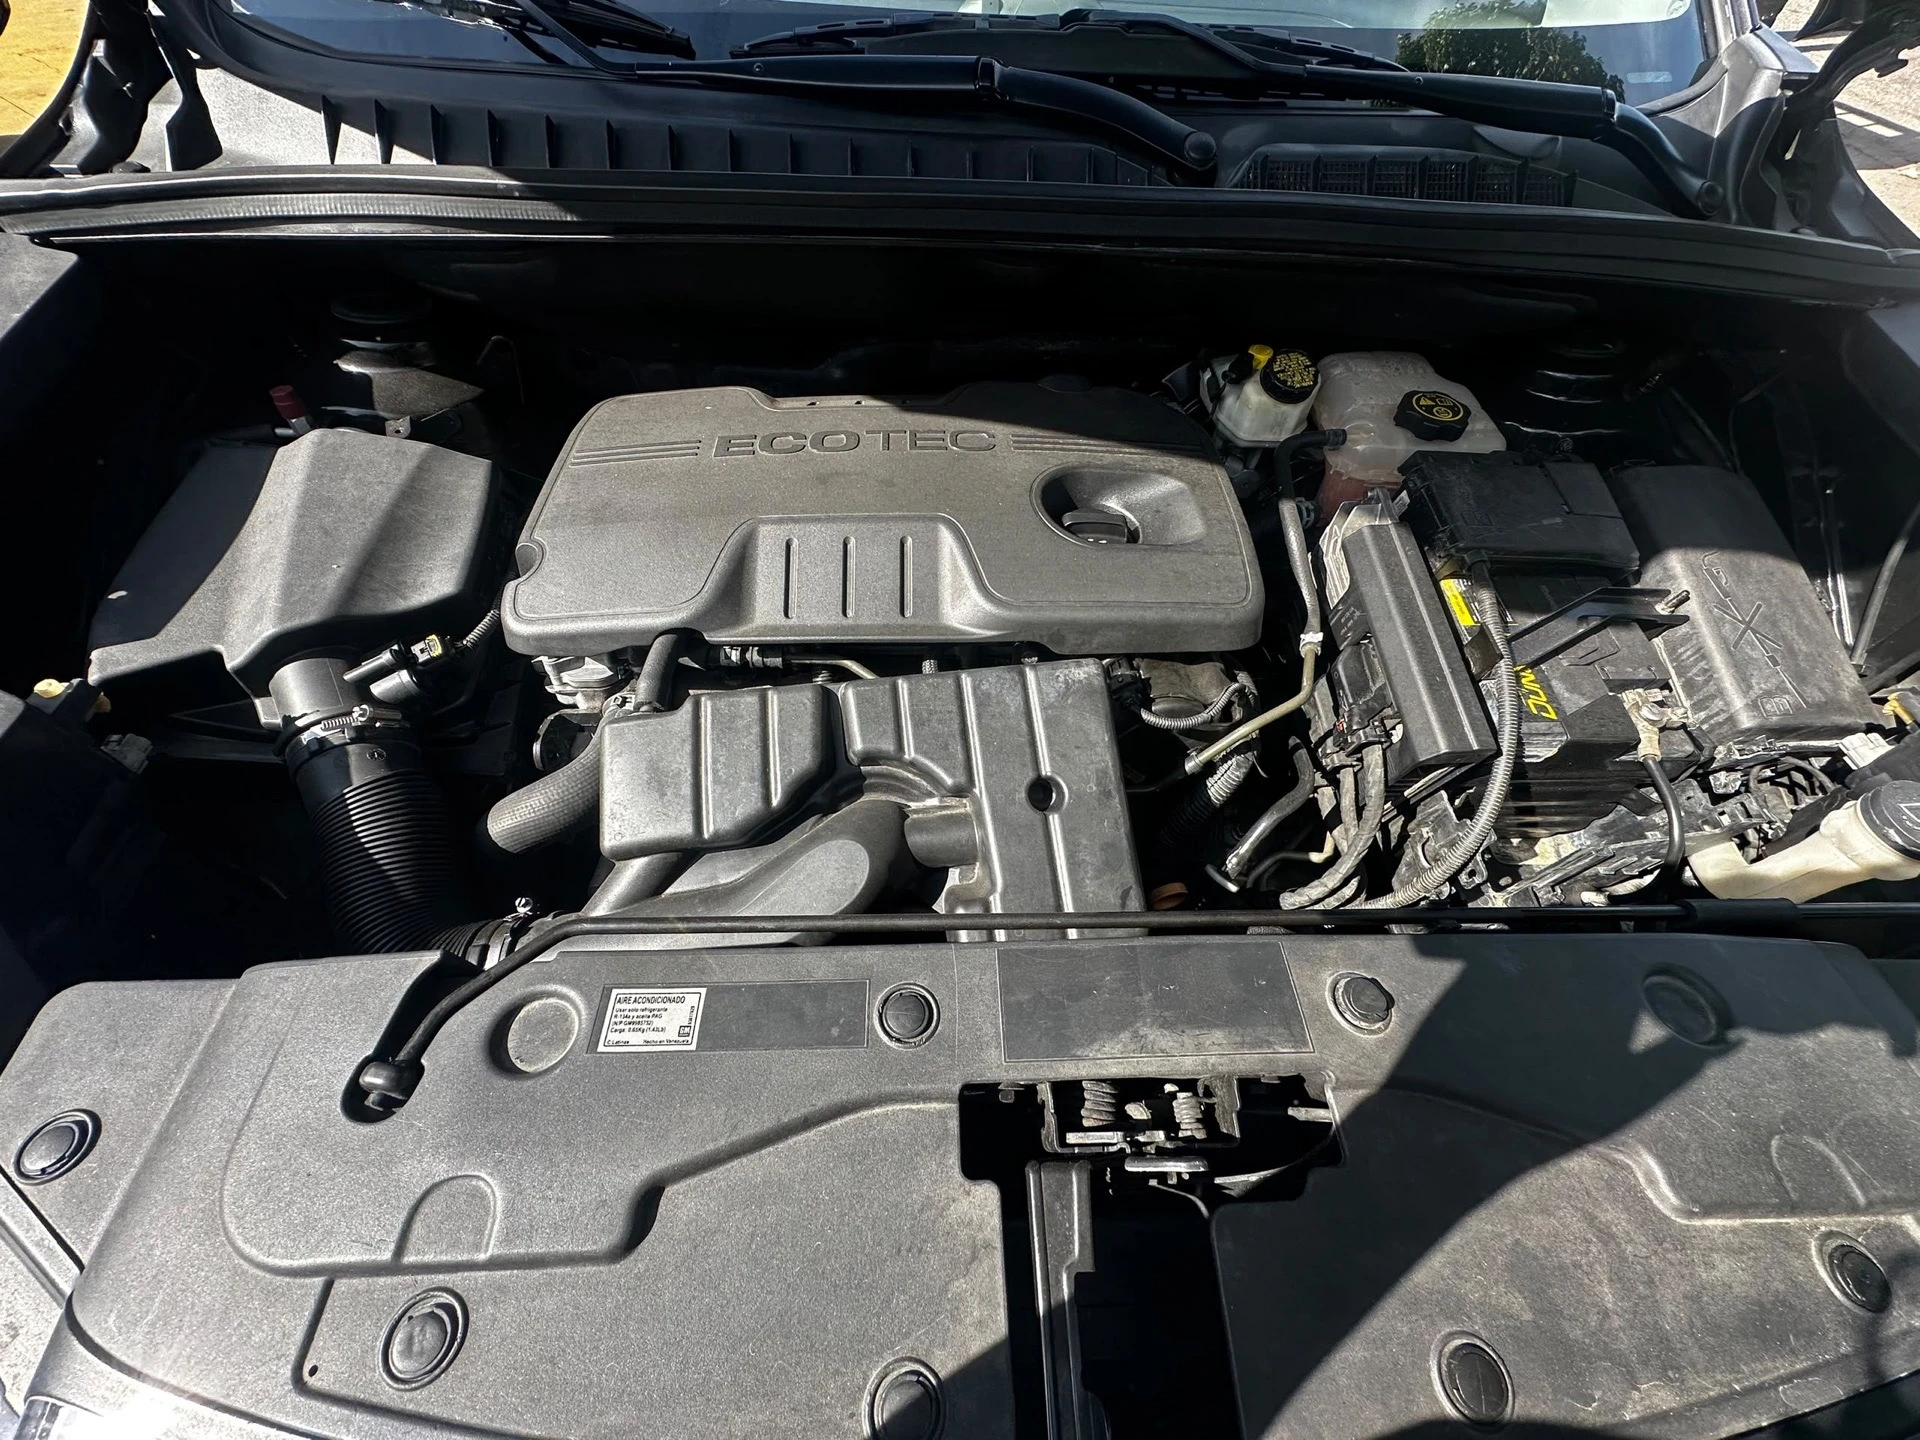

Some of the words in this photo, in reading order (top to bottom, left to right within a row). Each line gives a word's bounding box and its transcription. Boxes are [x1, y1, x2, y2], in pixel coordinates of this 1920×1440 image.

[712, 429, 997, 458] ECOTEC
[617, 996, 632, 1004] AIRE
[632, 996, 686, 1004] ACONDICIONADO
